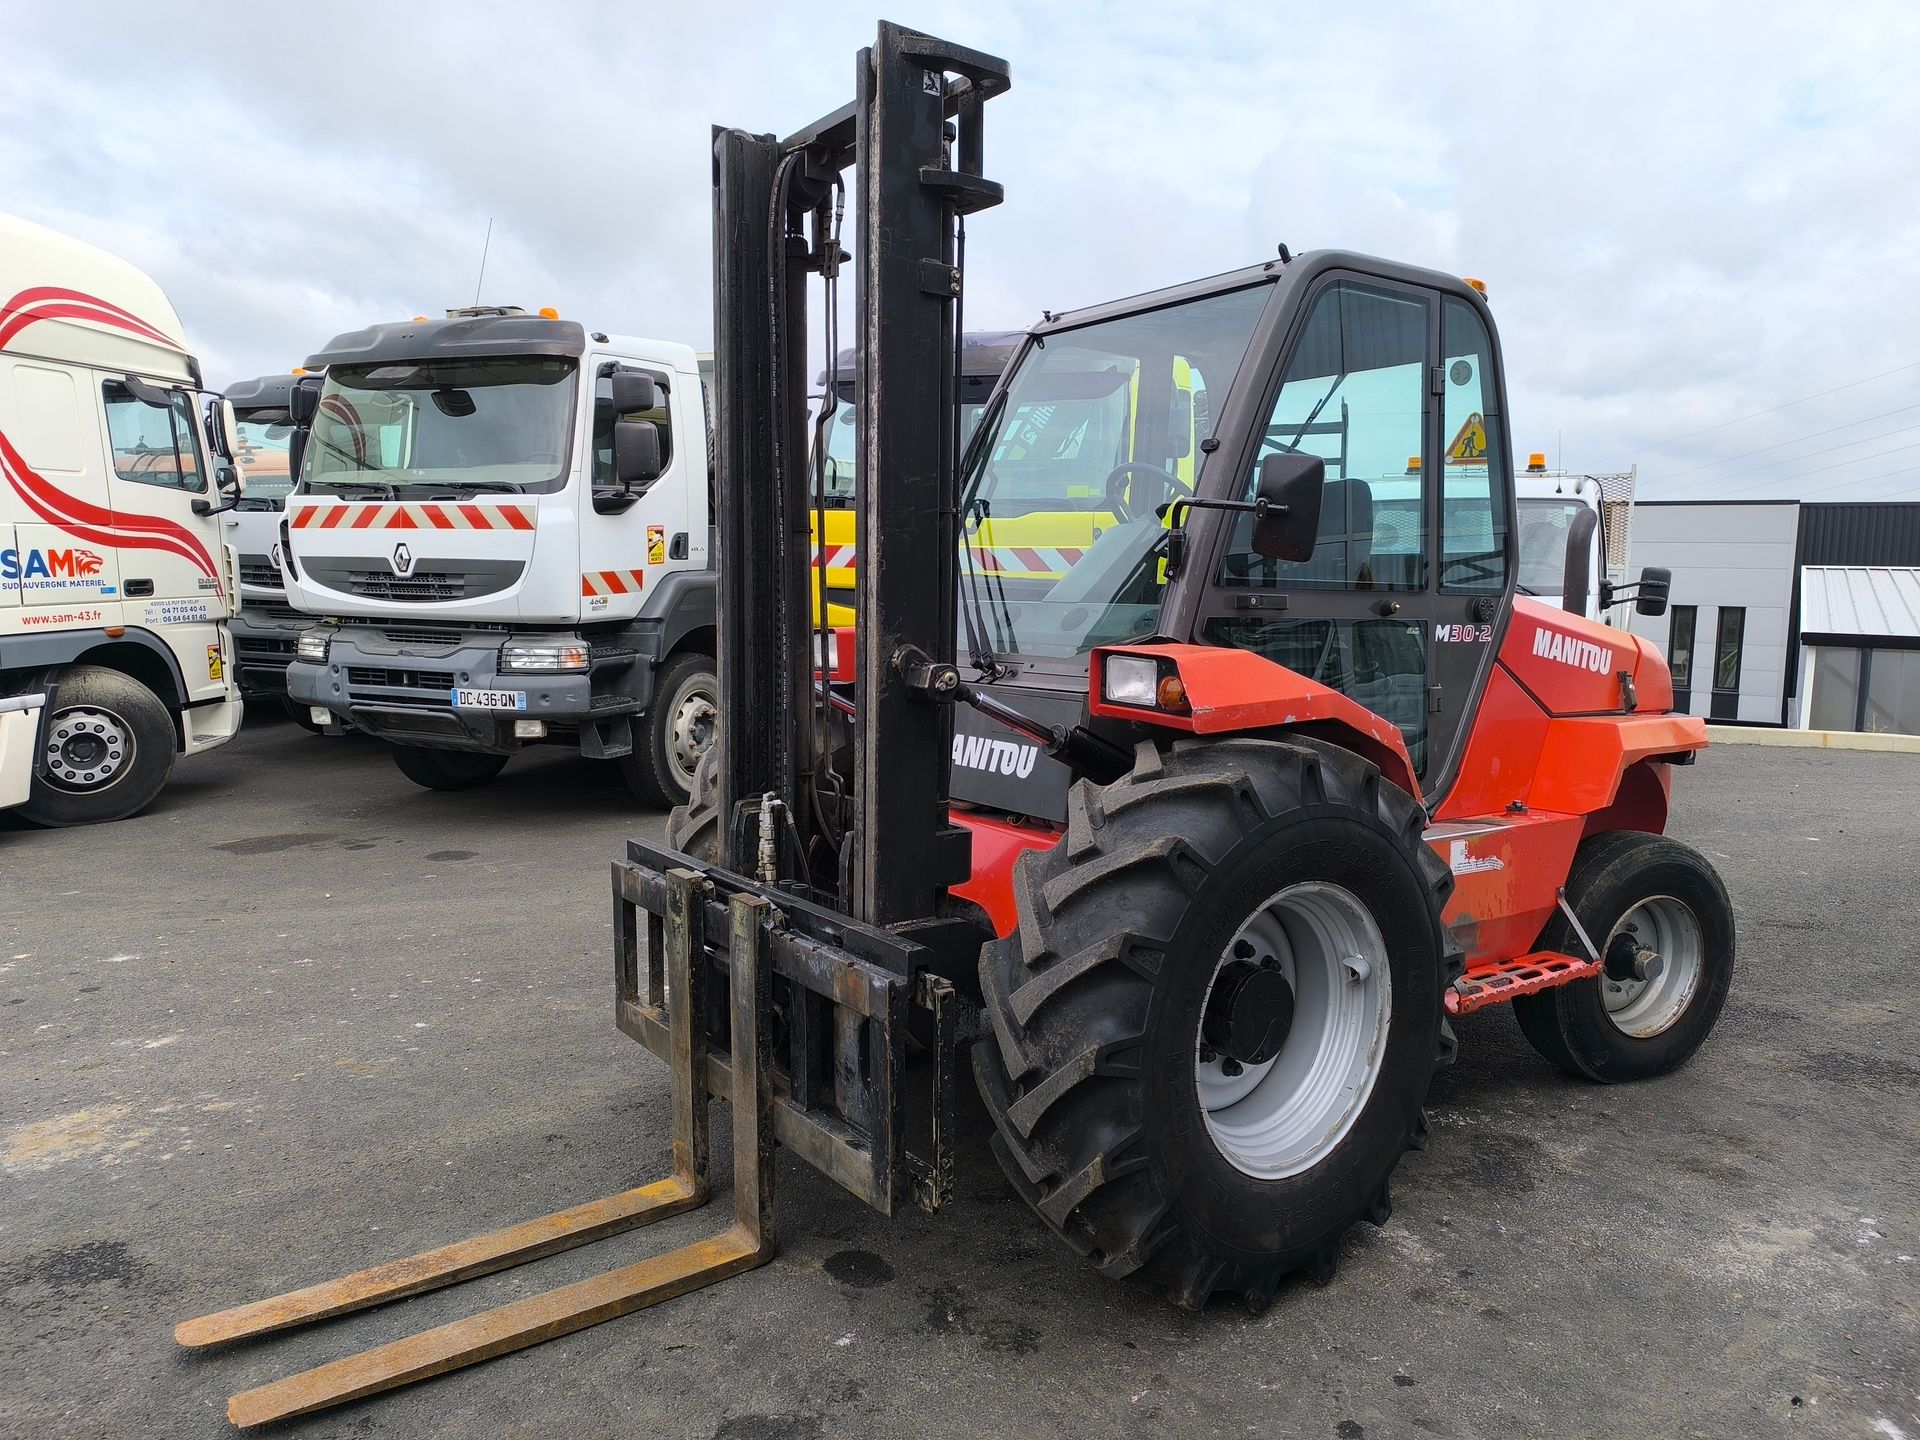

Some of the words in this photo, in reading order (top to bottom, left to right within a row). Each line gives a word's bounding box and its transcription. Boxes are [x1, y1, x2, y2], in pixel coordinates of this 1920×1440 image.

[0, 549, 75, 579] SAM
[2, 582, 20, 590] SUD
[22, 580, 67, 589] AUVERGNE
[69, 579, 106, 588] MATERIEL
[22, 610, 101, 625] www.sam-43.fr
[1532, 627, 1613, 675] MANITOU
[460, 692, 516, 707] DC-436-QN
[952, 734, 1038, 779] ANITOU
